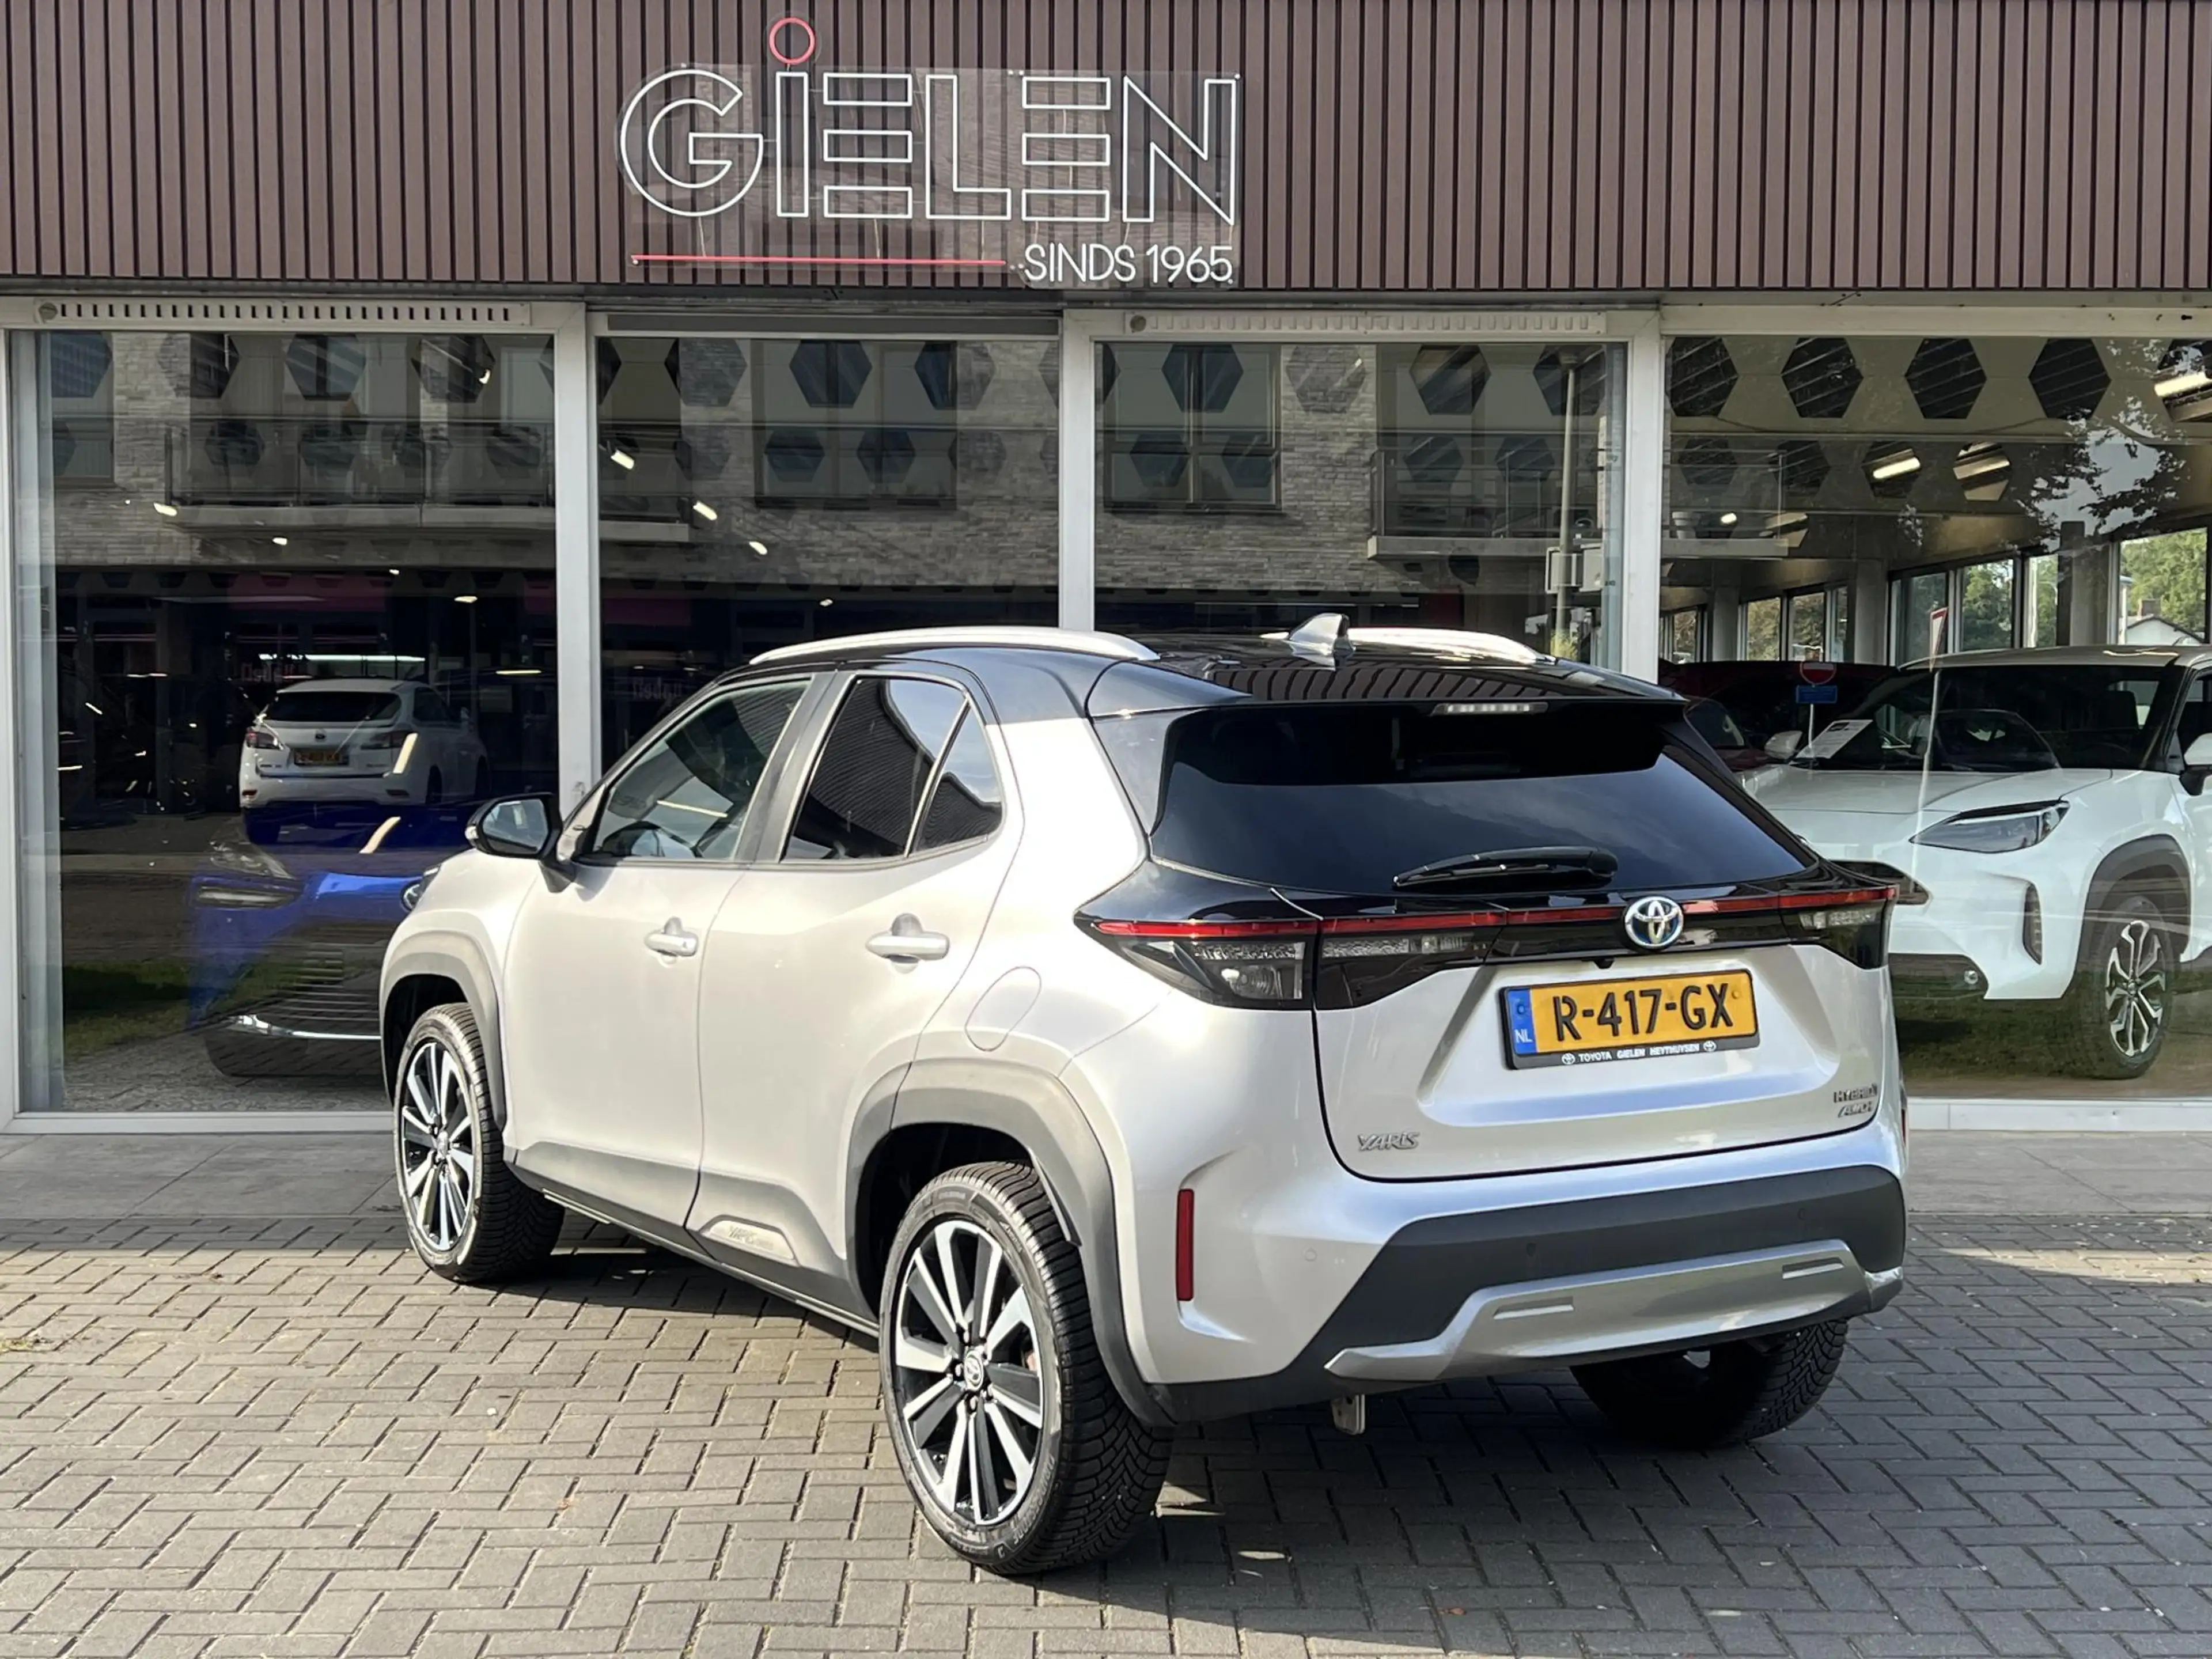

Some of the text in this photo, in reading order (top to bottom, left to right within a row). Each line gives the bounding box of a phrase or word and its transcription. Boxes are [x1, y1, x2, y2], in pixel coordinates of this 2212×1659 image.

[1024, 243, 1234, 283] SINDS 1965
[1552, 983, 1734, 1042] R-417-GX
[1515, 1029, 1533, 1044] NL
[1578, 1051, 1612, 1063] TOYOTA
[1616, 1048, 1646, 1059] GIELEN
